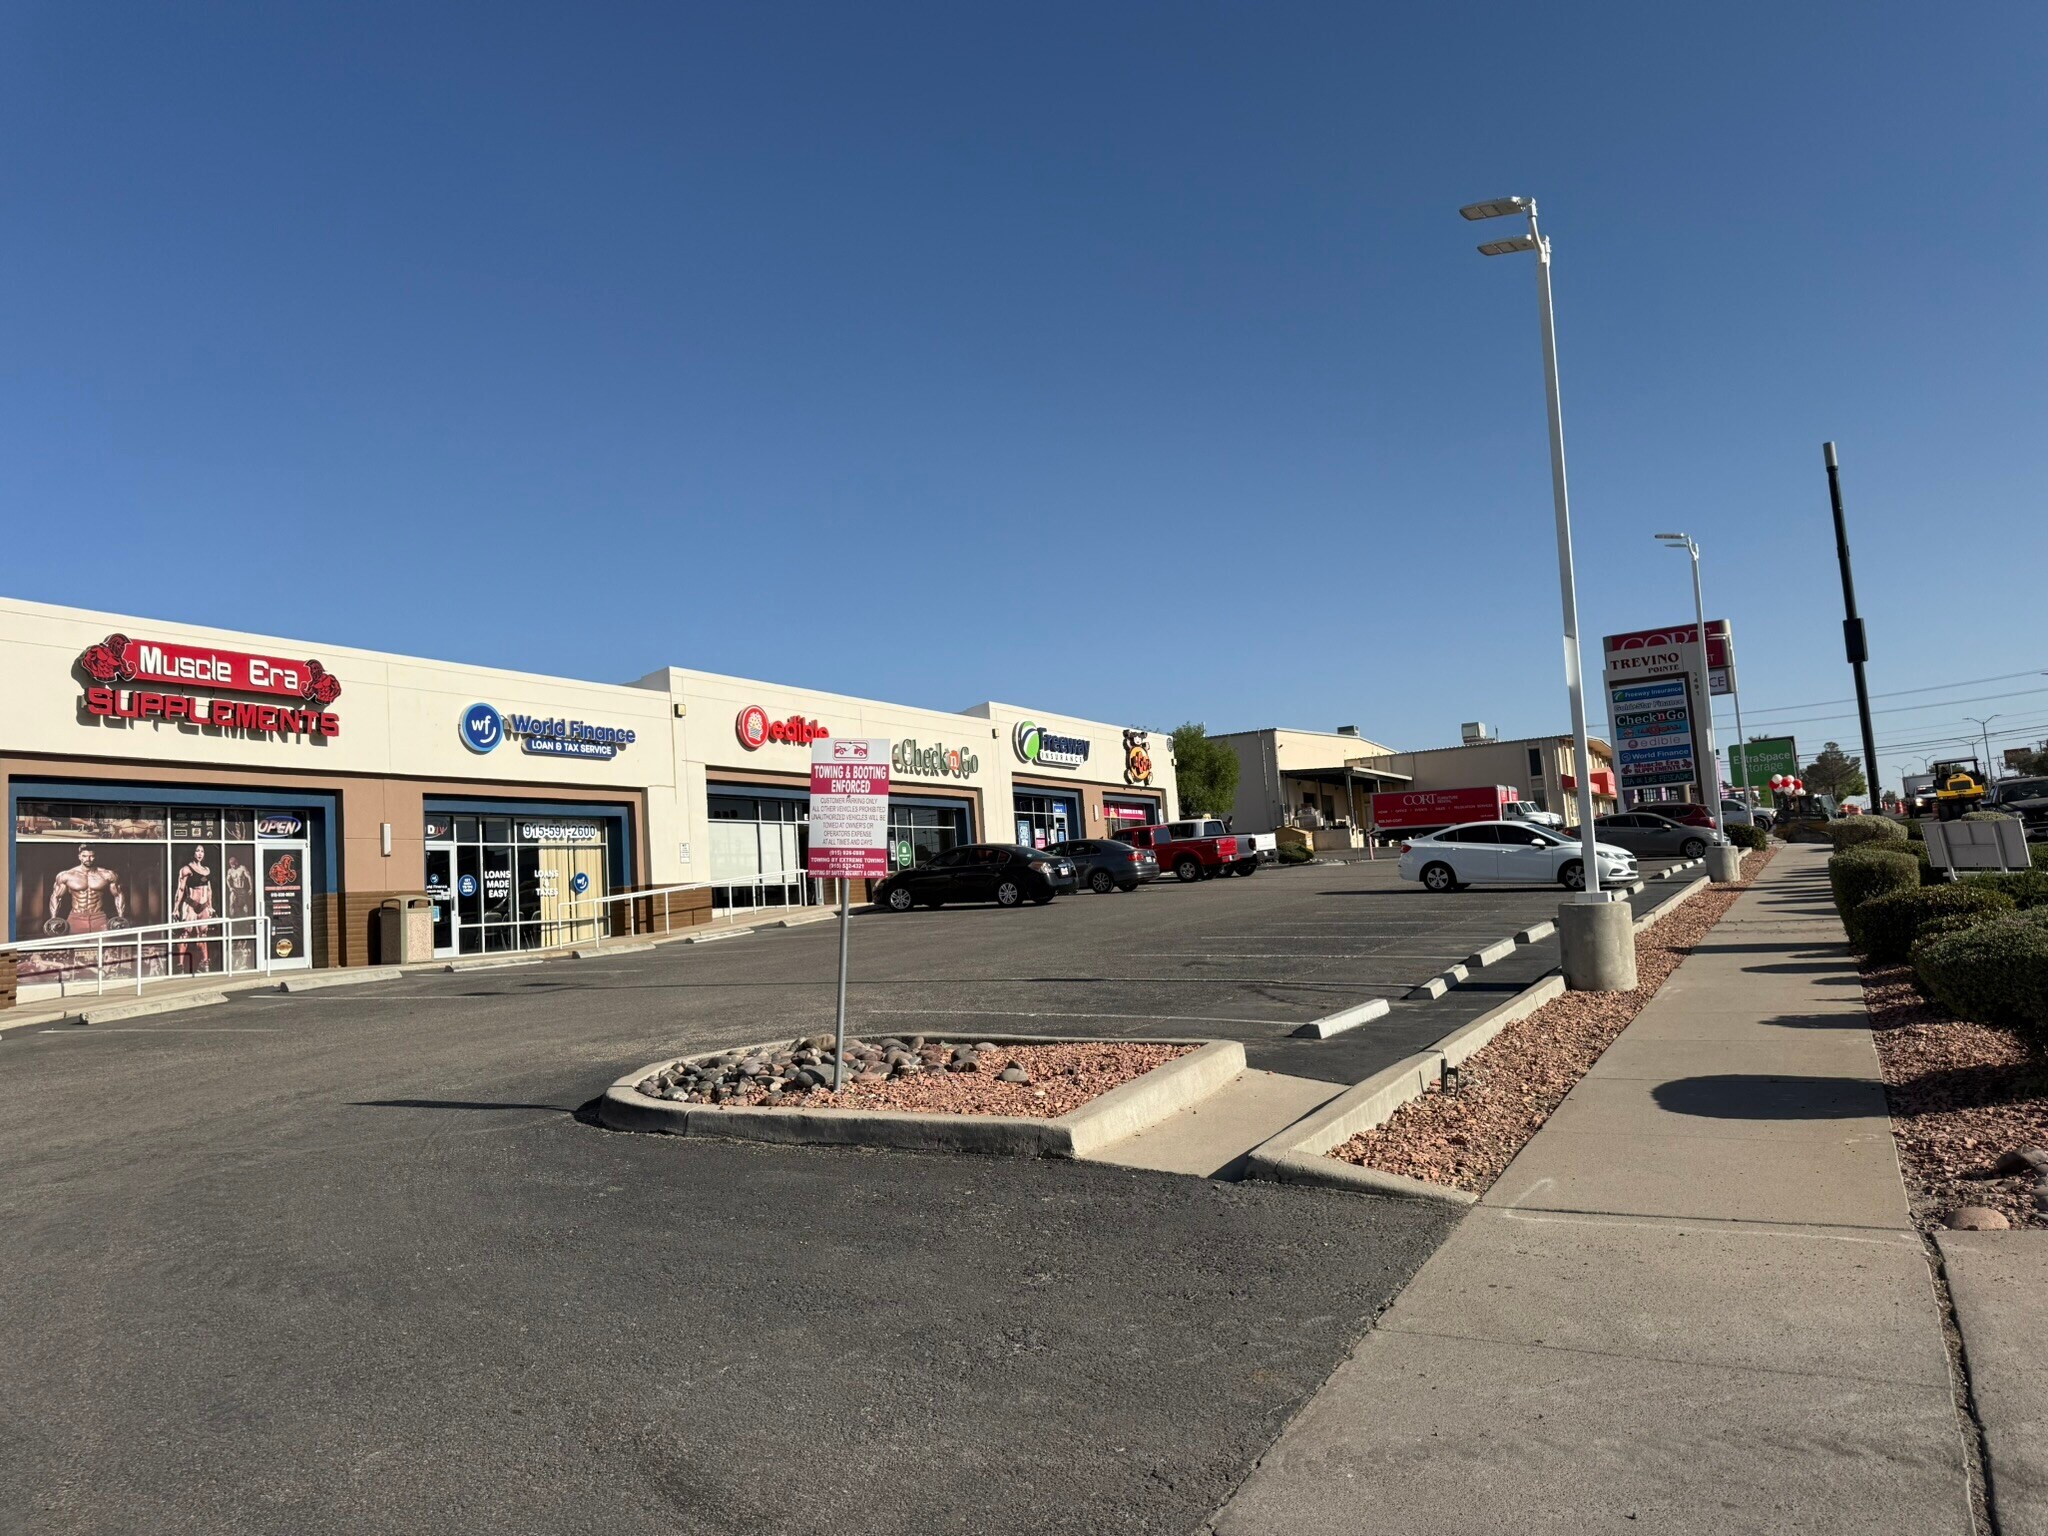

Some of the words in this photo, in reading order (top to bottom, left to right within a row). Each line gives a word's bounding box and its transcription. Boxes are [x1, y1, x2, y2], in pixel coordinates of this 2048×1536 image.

[140, 646, 231, 682] Muscle
[250, 660, 298, 688] Era
[1610, 652, 1679, 670] TREVINO
[1648, 664, 1679, 674] POINTE
[1624, 690, 1650, 698] Freeway
[1652, 686, 1682, 695] Insurance
[88, 686, 339, 736] SUPPLEMENTS
[1616, 712, 1656, 726] Check
[1666, 710, 1685, 720] Go
[472, 715, 492, 735] wf
[511, 714, 566, 738] World
[570, 720, 636, 744] Finance
[772, 716, 830, 742] edible
[532, 740, 554, 750] LOAN
[564, 742, 578, 752] TAX
[580, 744, 612, 754] SERVICE
[1036, 727, 1090, 761] Freeway
[1640, 736, 1680, 747] edible
[902, 738, 948, 770] Check
[960, 746, 978, 774] Go
[1041, 752, 1083, 763] INSURANCE
[1632, 752, 1656, 760] World
[1657, 748, 1688, 758] Finance
[814, 765, 843, 778] TOWING
[845, 766, 852, 778] &
[853, 766, 886, 780] BOOTING
[1634, 764, 1680, 774] SUPPLEMENTS
[1747, 762, 1784, 772] torage
[831, 780, 870, 793] ENFORCED
[1403, 794, 1437, 806] CORT
[259, 820, 296, 834] OPEN
[524, 824, 596, 838] 915-591-2600
[484, 870, 511, 879] LOANS
[534, 870, 559, 879] LOANS
[486, 880, 510, 888] MADE
[488, 890, 508, 898] EASY
[536, 888, 558, 896] TAXES
